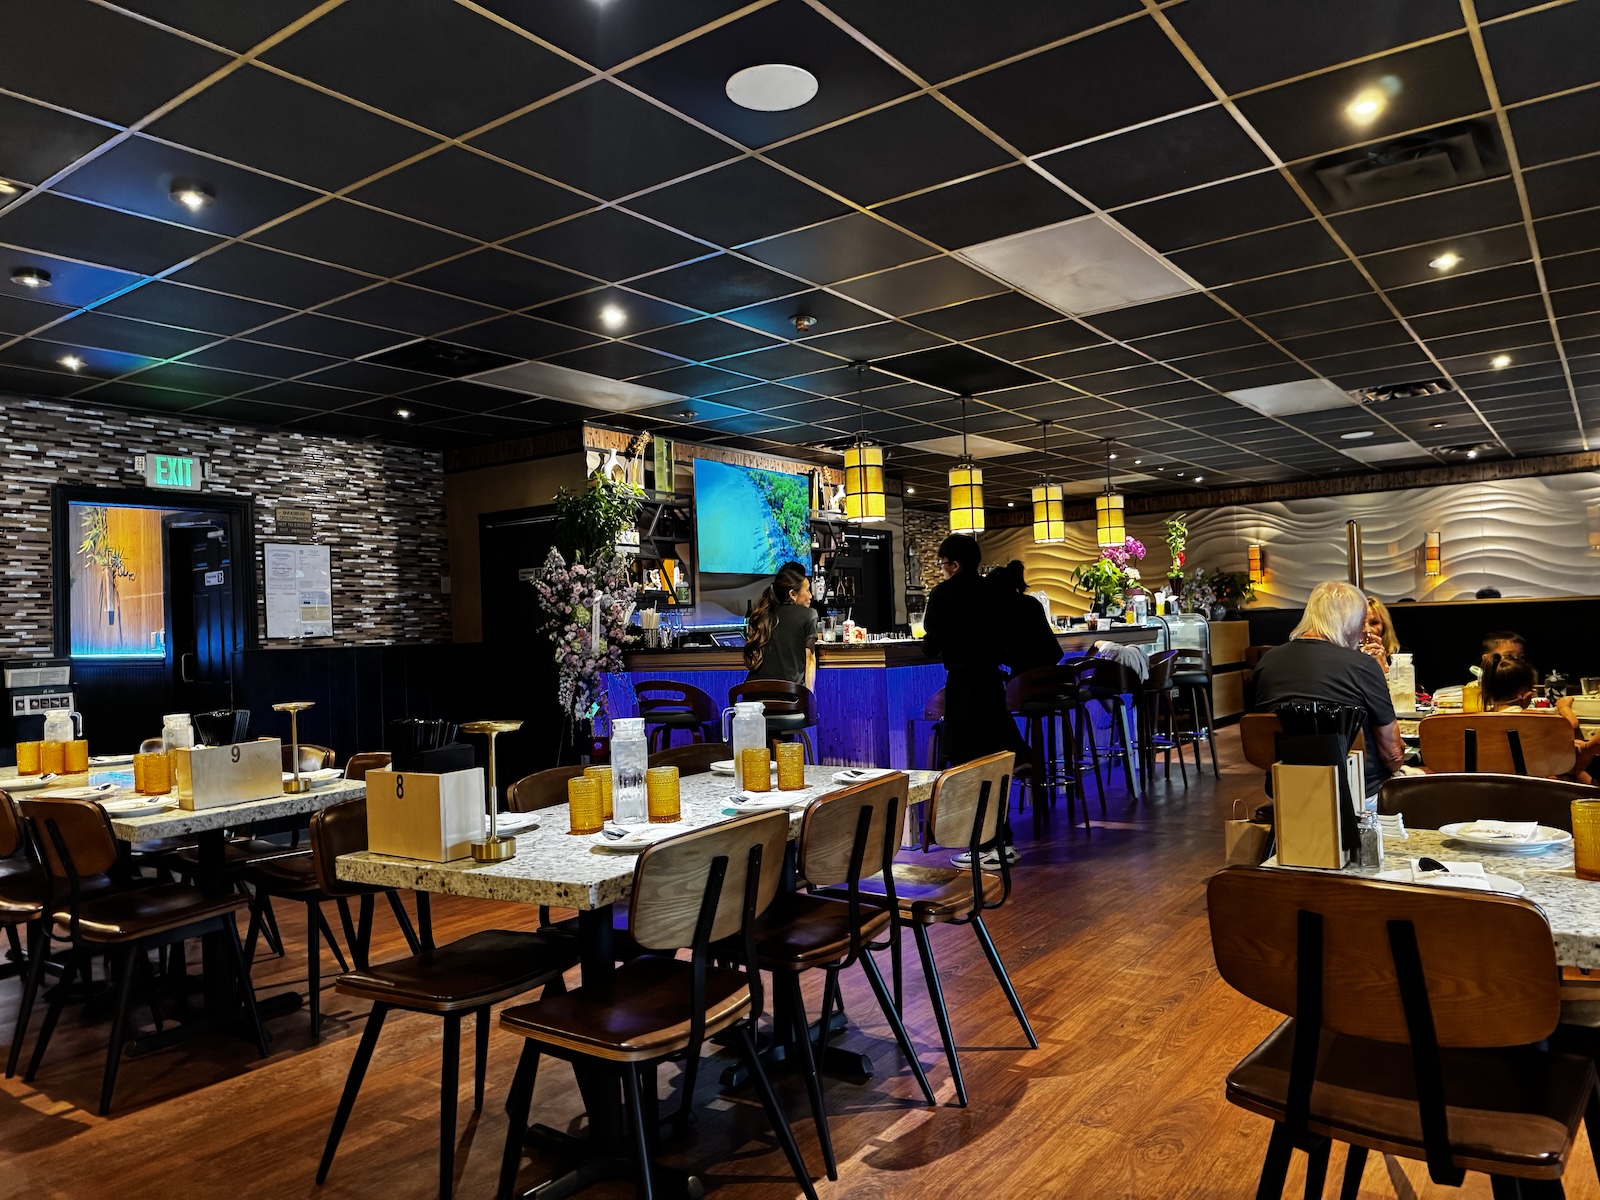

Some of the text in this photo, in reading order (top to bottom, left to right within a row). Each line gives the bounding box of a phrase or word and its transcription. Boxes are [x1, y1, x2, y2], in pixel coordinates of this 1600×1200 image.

[156, 455, 193, 486] EXIT
[231, 745, 241, 763] 9
[396, 774, 404, 799] 8
